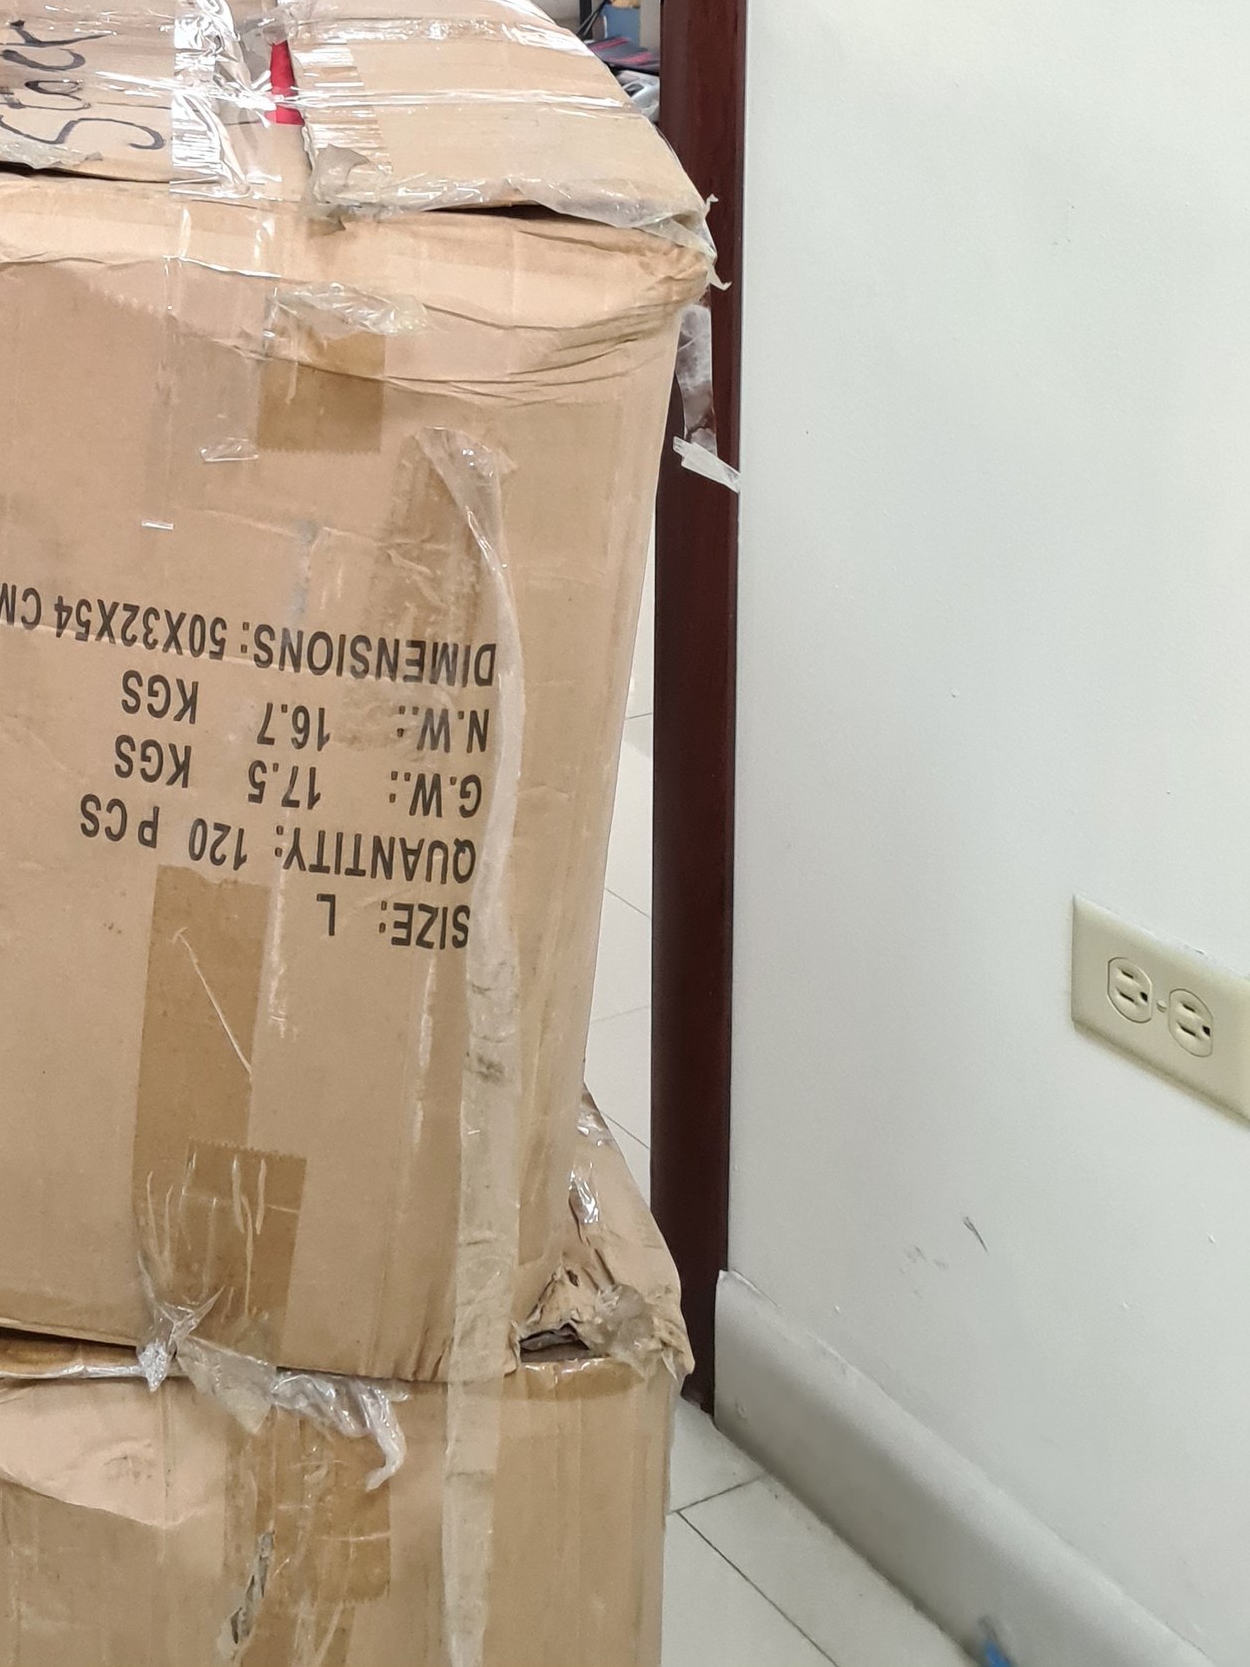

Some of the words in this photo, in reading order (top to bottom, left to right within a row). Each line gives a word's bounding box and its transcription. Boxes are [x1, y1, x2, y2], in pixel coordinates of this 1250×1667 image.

[53, 594, 228, 662] 50X32X54
[240, 621, 497, 688] DIMENSIONS:
[121, 669, 199, 725] KGS
[256, 701, 331, 752] 16.7
[396, 705, 490, 754] N.W.:
[114, 734, 192, 789] KGS
[247, 759, 322, 811] 17.5
[389, 770, 483, 819] G.W.:
[188, 817, 248, 871] 120
[274, 825, 477, 884] QUANTITY:
[316, 893, 337, 937] L
[380, 900, 471, 951] SIZE:
